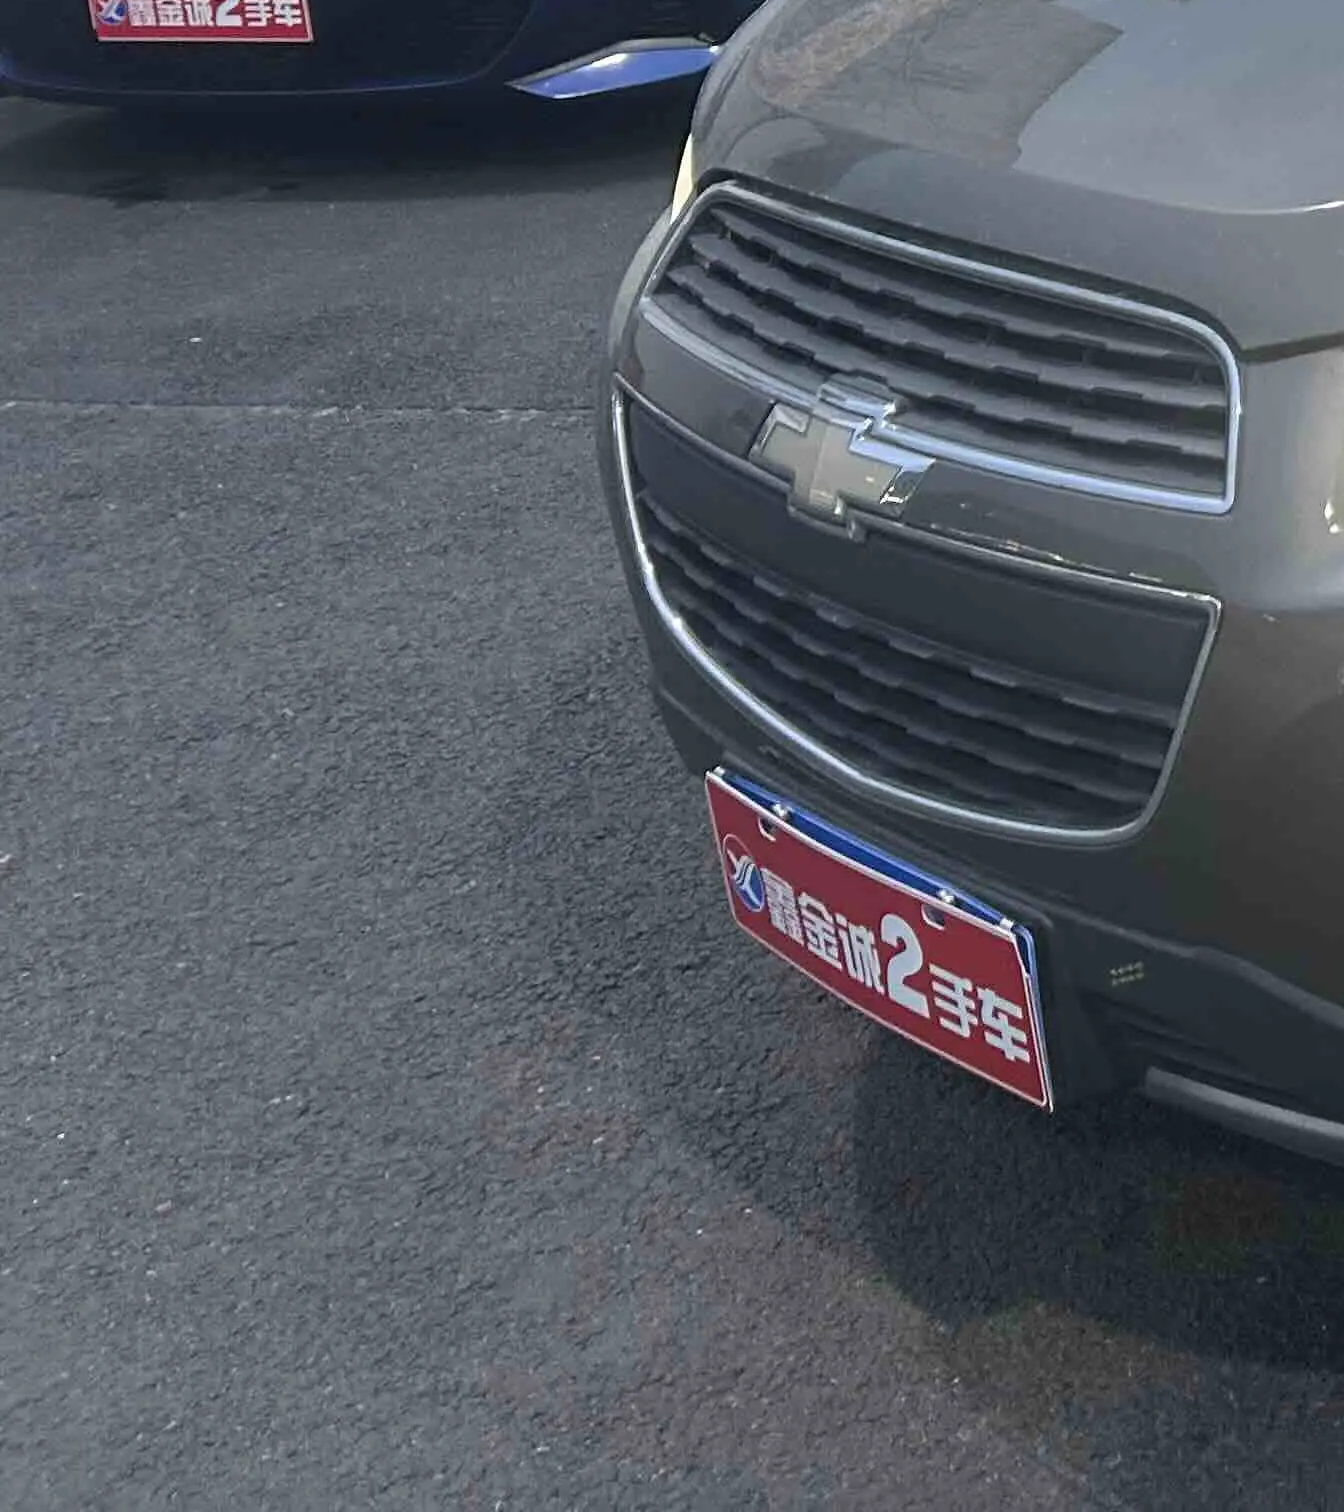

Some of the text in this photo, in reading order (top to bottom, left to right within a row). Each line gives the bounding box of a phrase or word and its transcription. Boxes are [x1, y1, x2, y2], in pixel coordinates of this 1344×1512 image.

[760, 868, 1030, 1063] 鑫金诚2手车
